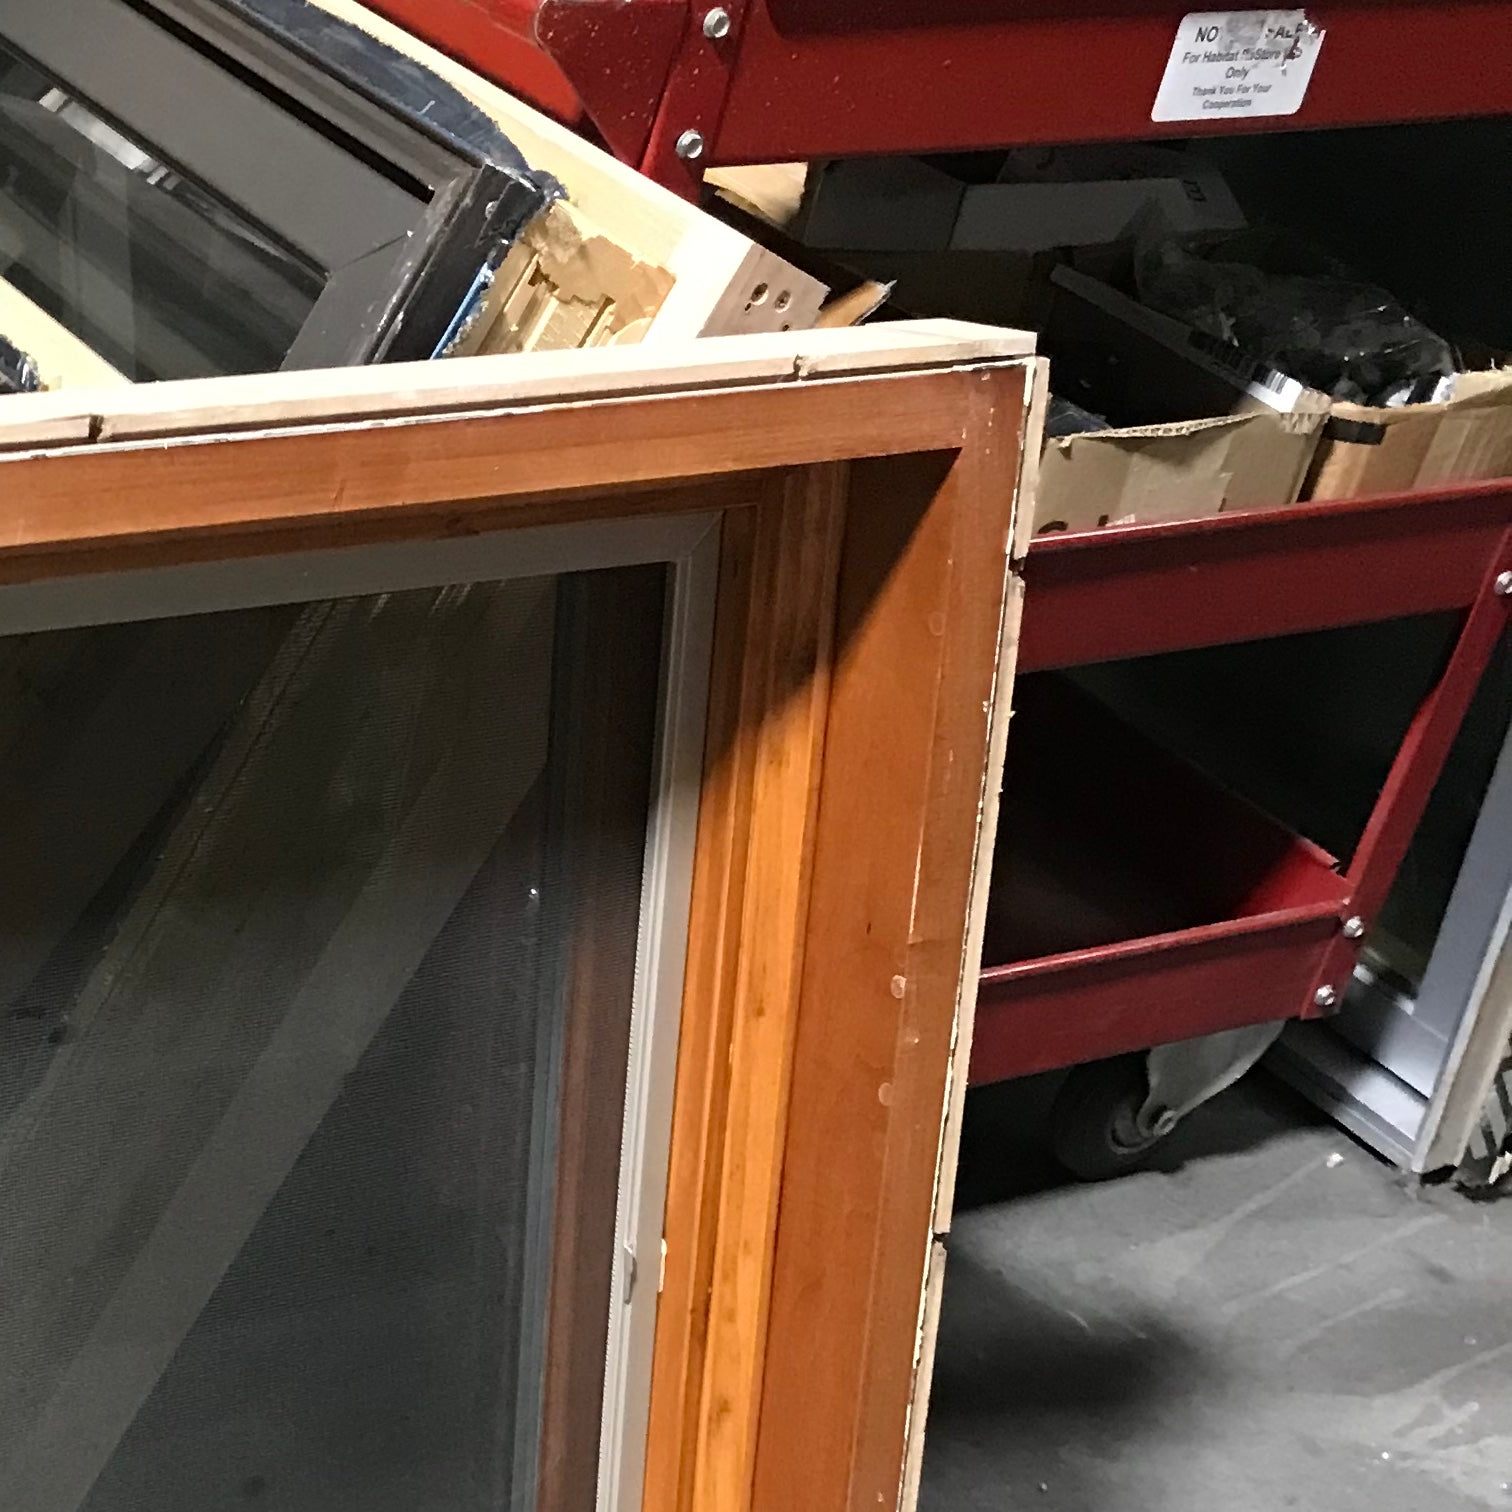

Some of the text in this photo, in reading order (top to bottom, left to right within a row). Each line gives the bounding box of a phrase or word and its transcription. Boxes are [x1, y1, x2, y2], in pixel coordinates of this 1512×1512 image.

[1182, 51, 1201, 64] For
[1225, 66, 1250, 80] Only
[1192, 83, 1273, 97] Thank You For Your
